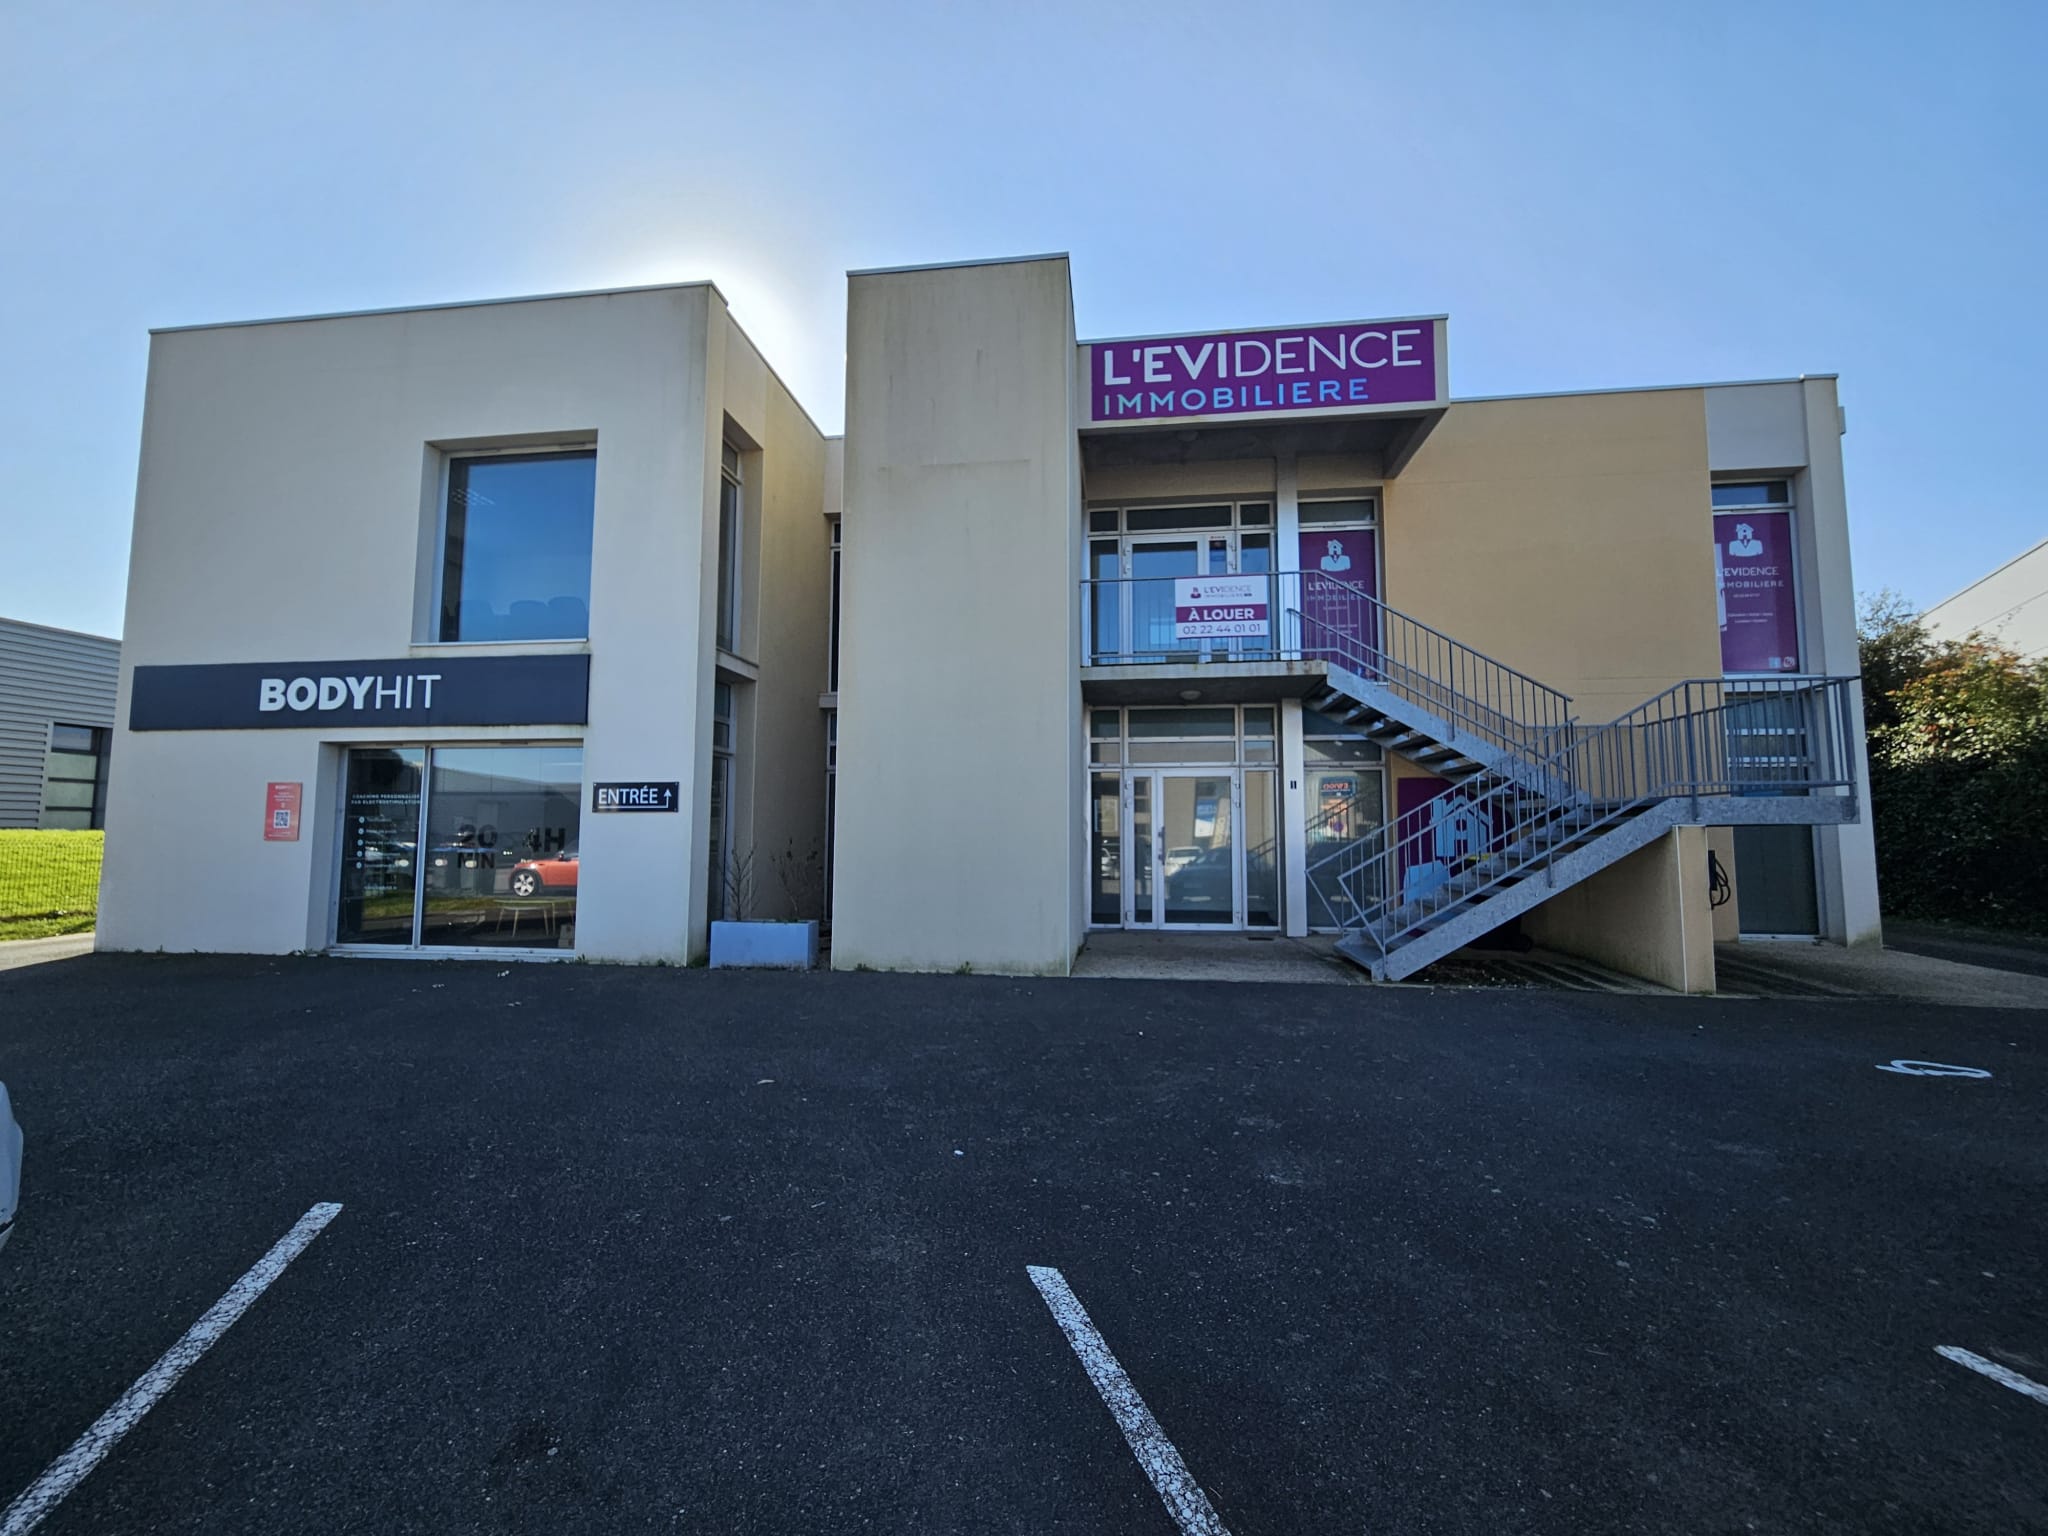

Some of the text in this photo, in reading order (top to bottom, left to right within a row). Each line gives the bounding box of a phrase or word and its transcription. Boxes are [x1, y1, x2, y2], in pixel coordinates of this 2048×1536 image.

[1104, 328, 1422, 386] L'EVIDENCE
[1104, 378, 1369, 416] IMMOBILIERE
[1188, 607, 1255, 621] À LOUER
[1183, 625, 1197, 635] 02
[1200, 625, 1213, 634] 22
[1234, 624, 1246, 633] 01
[1249, 623, 1260, 633] 01
[259, 674, 442, 711] BODYHIT
[598, 785, 658, 804] ENTRÉE
